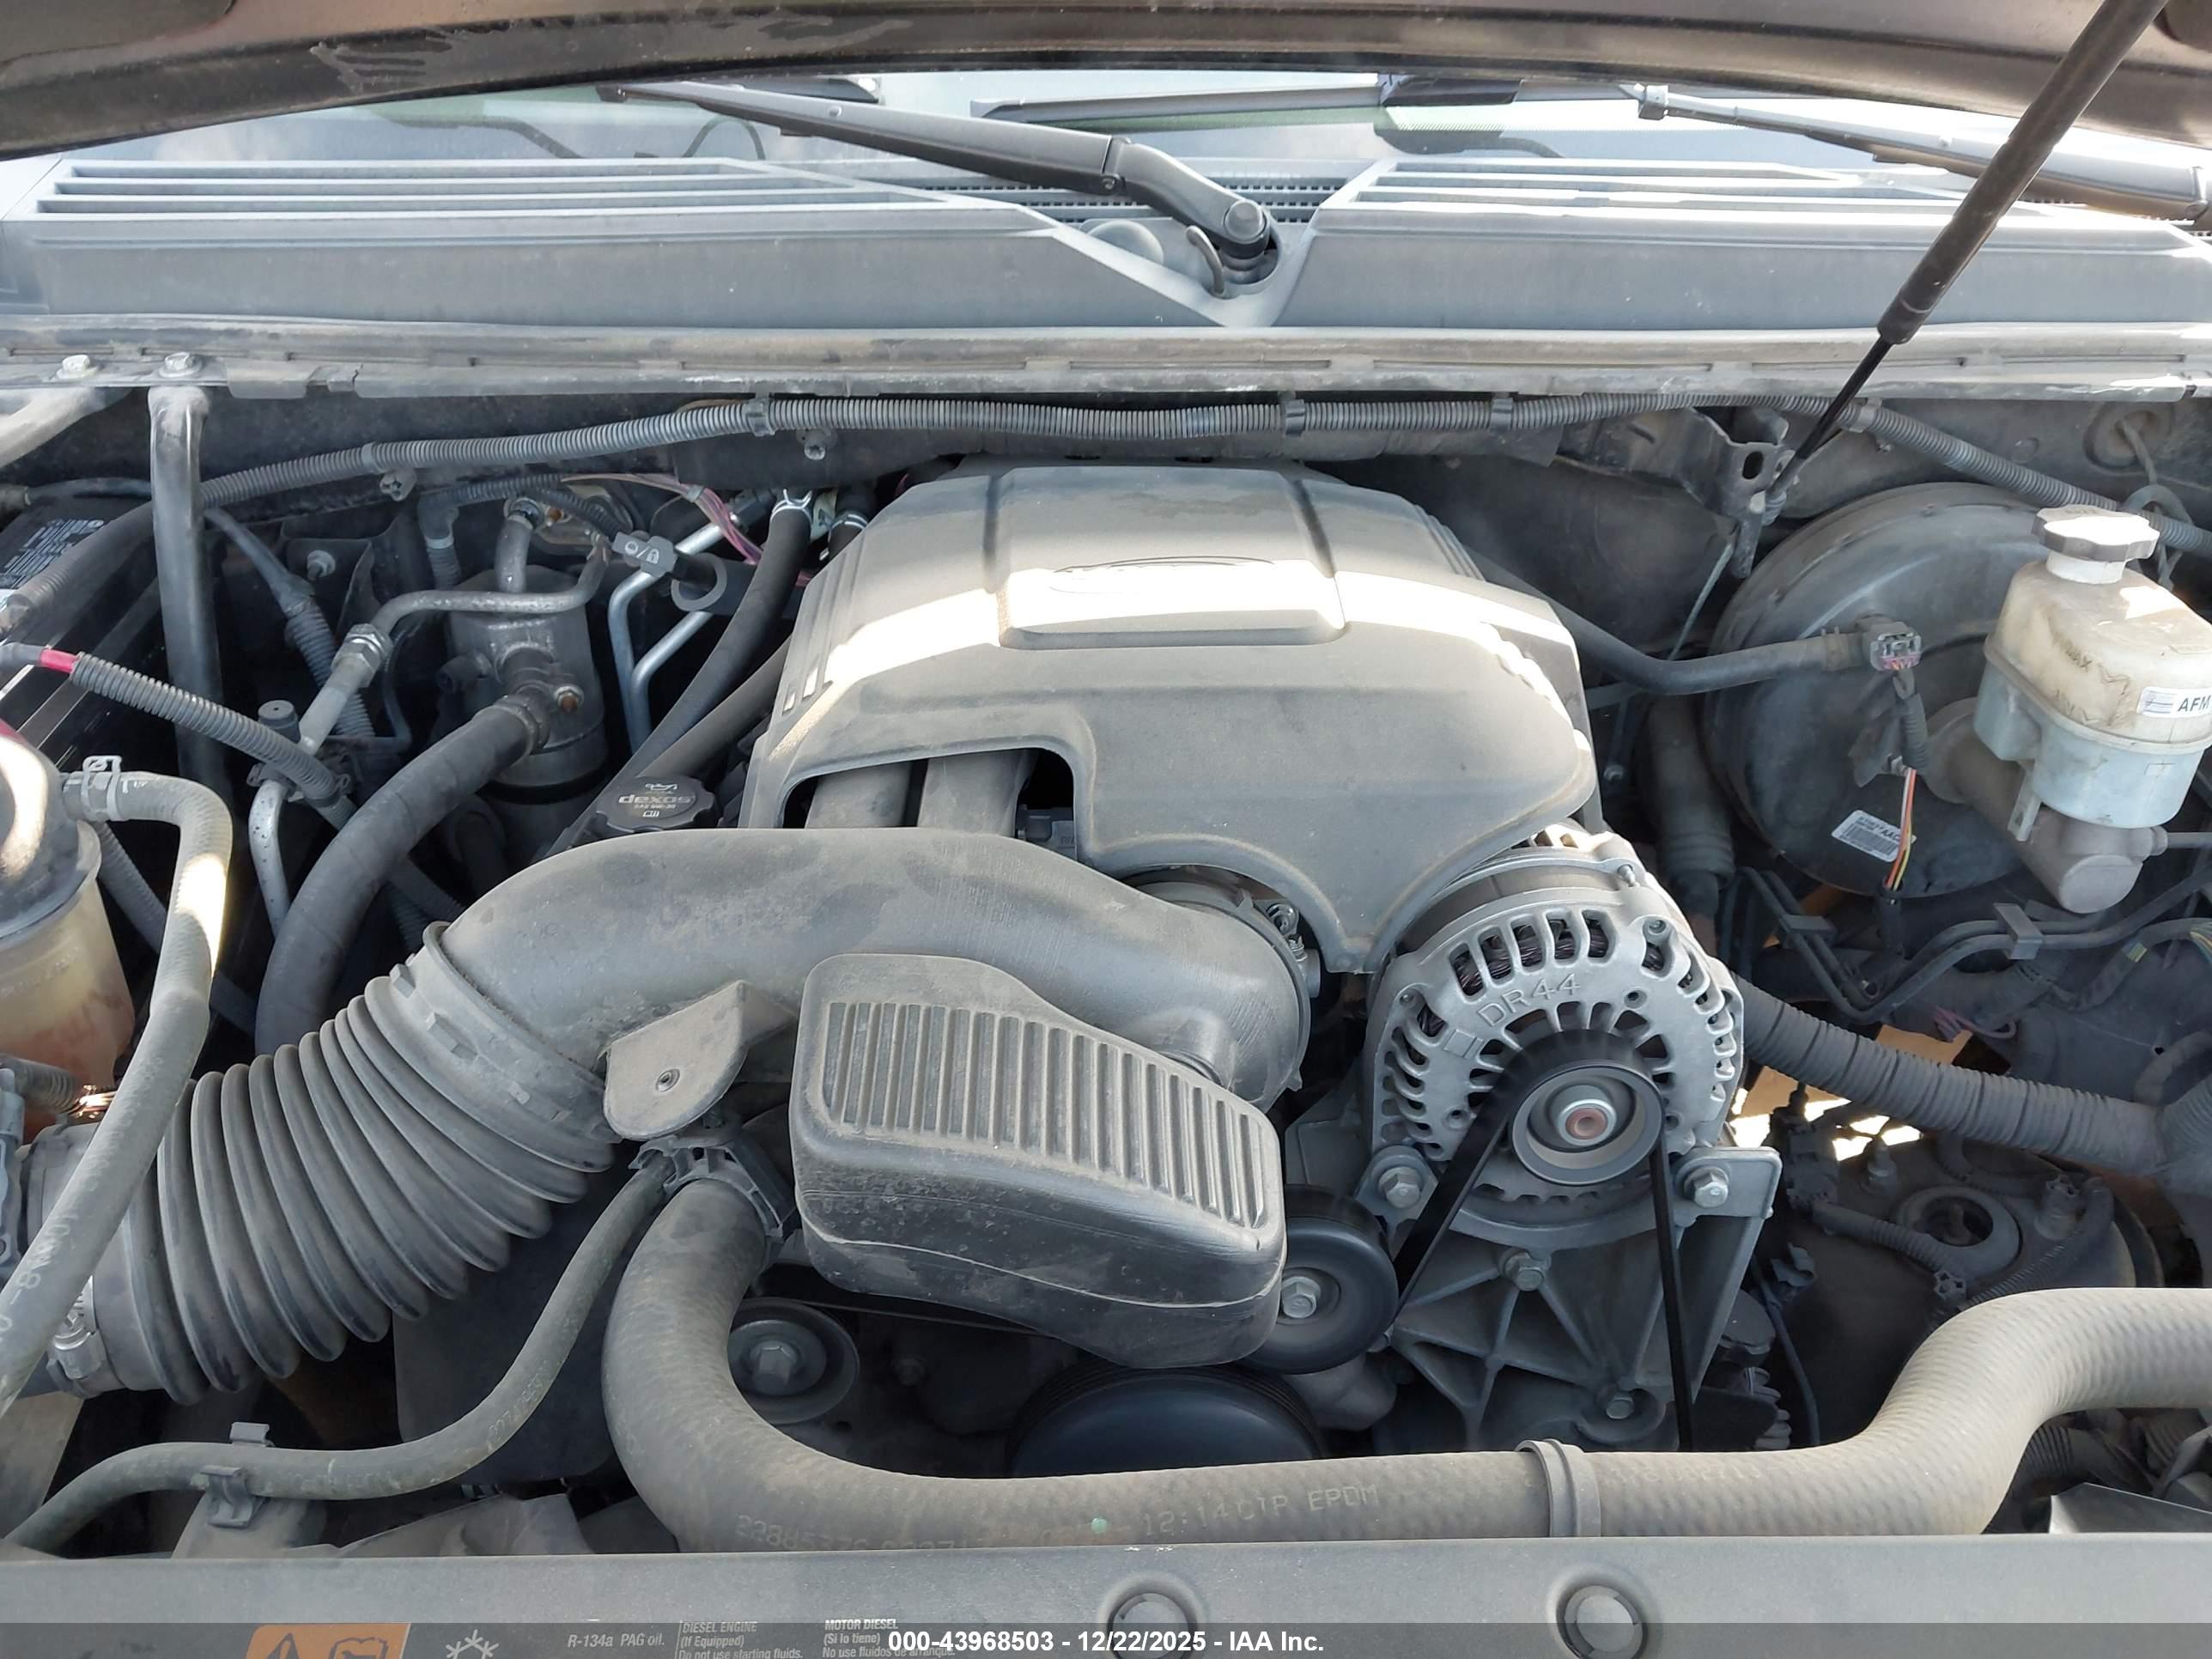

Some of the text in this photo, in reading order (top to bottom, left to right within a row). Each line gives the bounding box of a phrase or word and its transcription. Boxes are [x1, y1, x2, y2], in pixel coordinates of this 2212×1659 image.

[619, 794, 691, 804] dexos
[1477, 973, 1581, 1027] DR44
[1308, 1483, 1379, 1511] EPDM
[682, 1621, 757, 1633] DIESEL ENGINE
[824, 1619, 898, 1631] MOTOR DIESEL
[567, 1633, 665, 1648] R-134a PAG oil.
[694, 1635, 744, 1649] Equipped)
[823, 1633, 881, 1645] (Si lo tiene)
[678, 1650, 693, 1659] Do
[695, 1650, 710, 1659] not
[733, 1649, 771, 1659] starting
[774, 1648, 803, 1658] fluids.
[823, 1647, 836, 1658] No
[838, 1649, 856, 1657] use
[859, 1647, 891, 1657] fluidos
